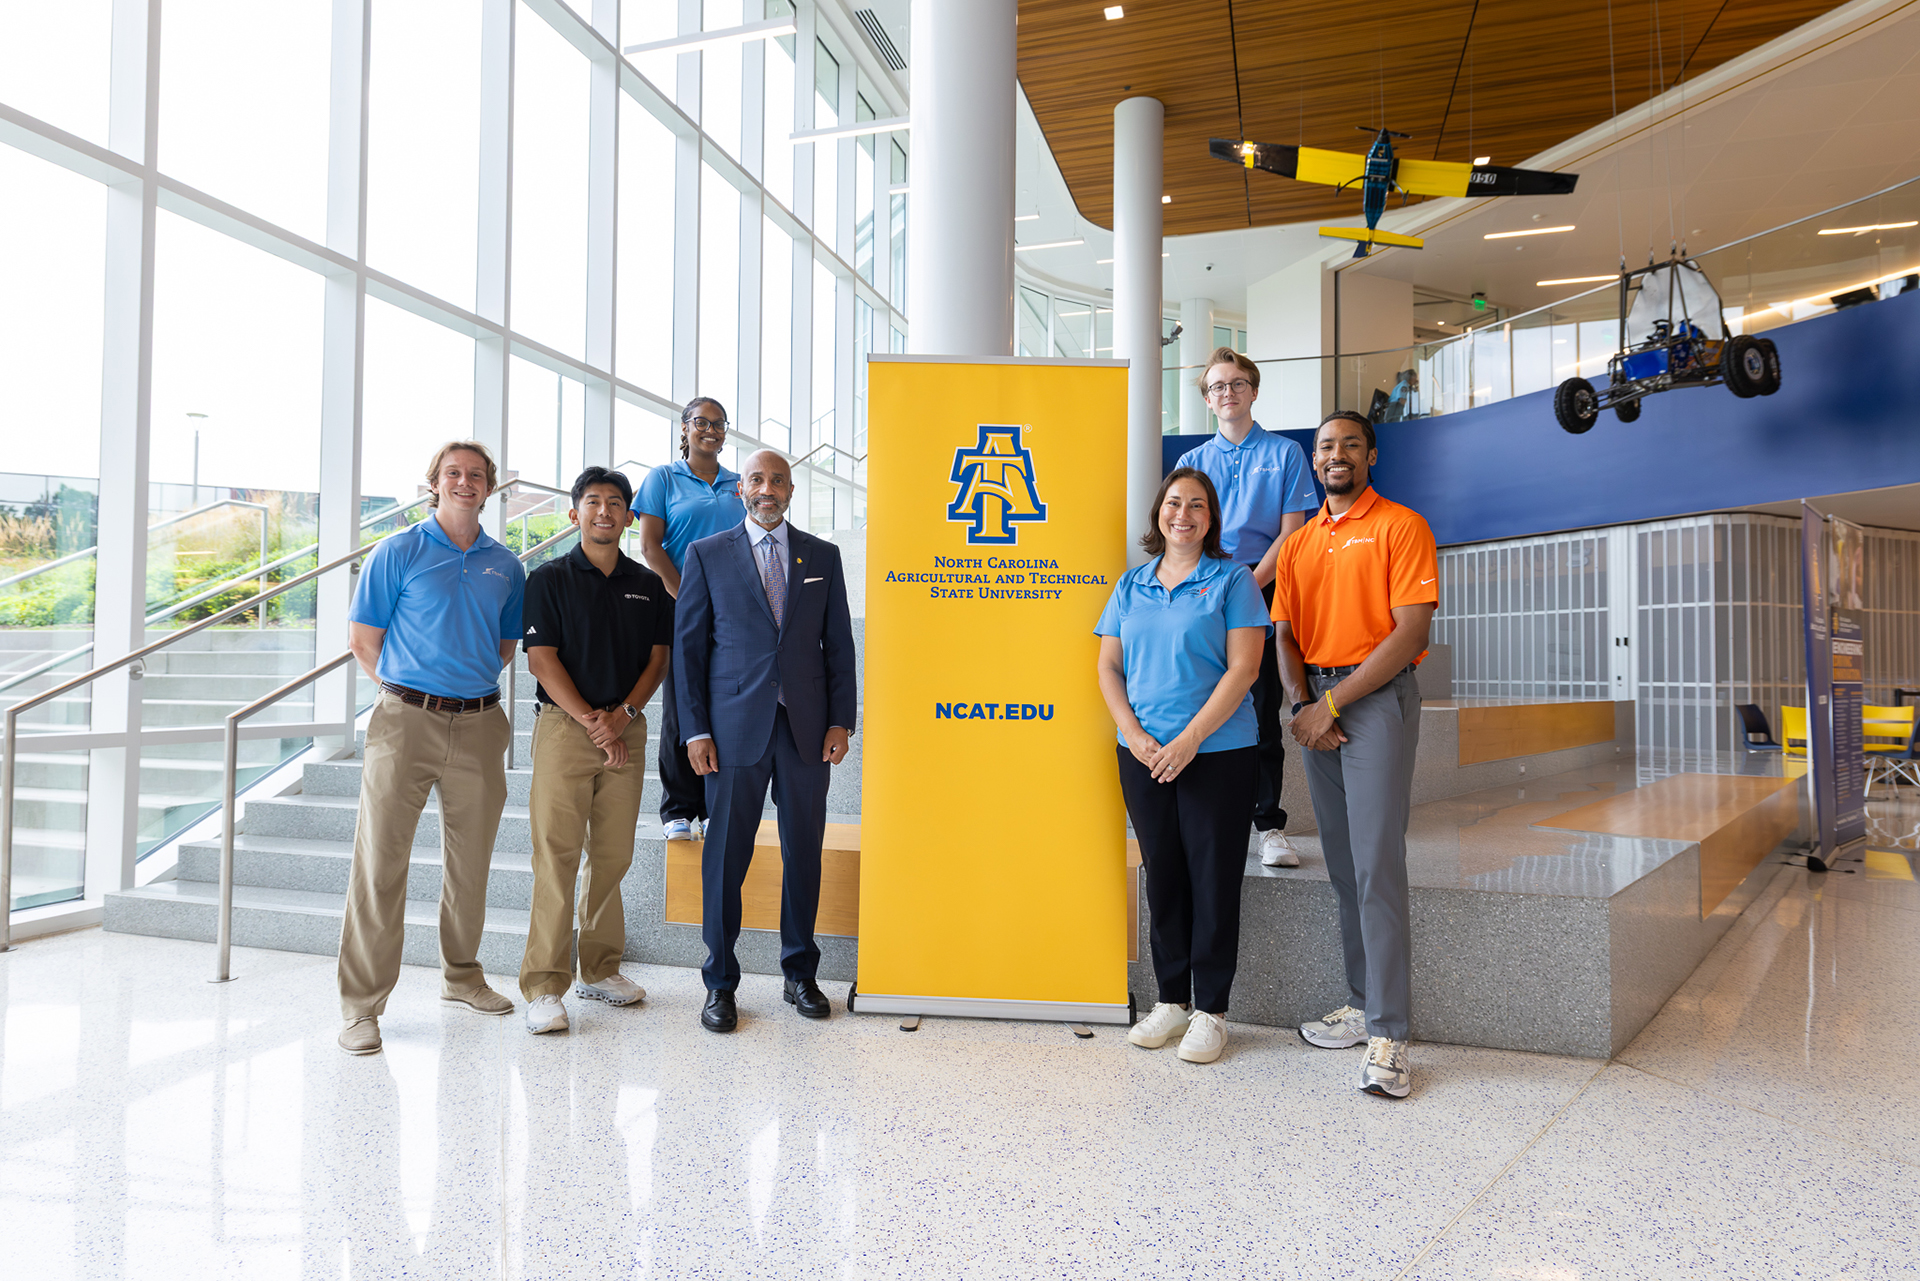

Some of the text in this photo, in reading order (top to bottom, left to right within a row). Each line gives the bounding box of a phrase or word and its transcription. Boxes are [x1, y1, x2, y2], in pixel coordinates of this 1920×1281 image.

[1471, 172, 1496, 184] 050
[934, 556, 1059, 569] NORTH CAROLINA
[885, 571, 1108, 585] AGRICULTURAL AND TECHNICAL
[631, 594, 651, 602] TOYOTA
[930, 586, 1063, 600] STATE UNIVERSITY
[935, 702, 1054, 721] NCAT.EDU
